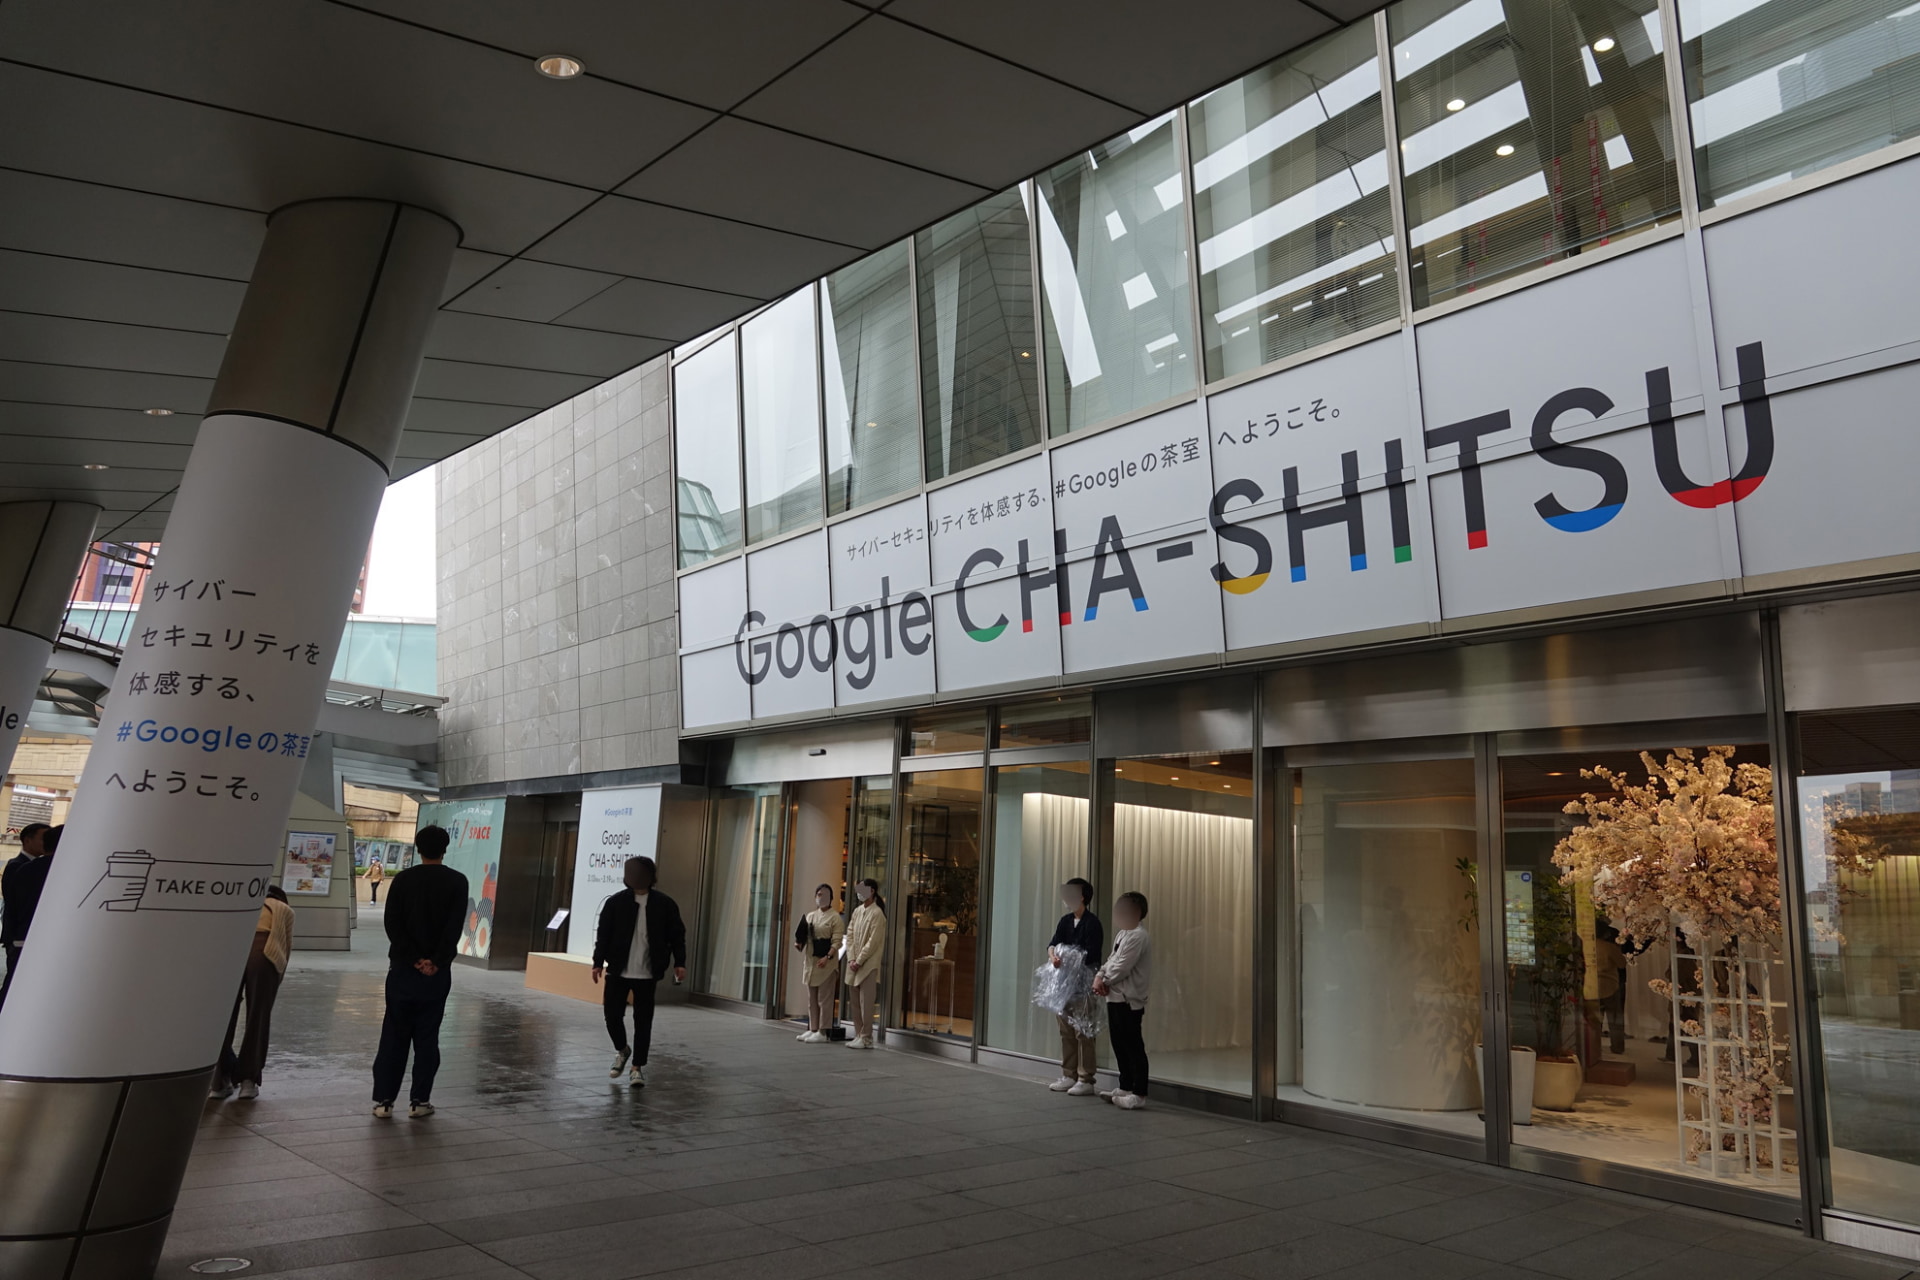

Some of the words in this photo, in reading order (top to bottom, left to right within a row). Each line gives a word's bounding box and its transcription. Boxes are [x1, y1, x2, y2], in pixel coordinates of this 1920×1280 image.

[735, 575, 933, 691] Google
[954, 341, 1775, 643] CHA-SHITSU
[153, 578, 257, 603] サイバー
[140, 623, 320, 665] セキュリティを
[128, 670, 255, 702] 体感する、
[105, 768, 259, 802] へようこそ。
[468, 825, 492, 840] SPACE
[602, 830, 631, 849] Google
[155, 878, 206, 895] TAKE
[210, 880, 245, 896] OUT
[247, 877, 270, 898] OK
